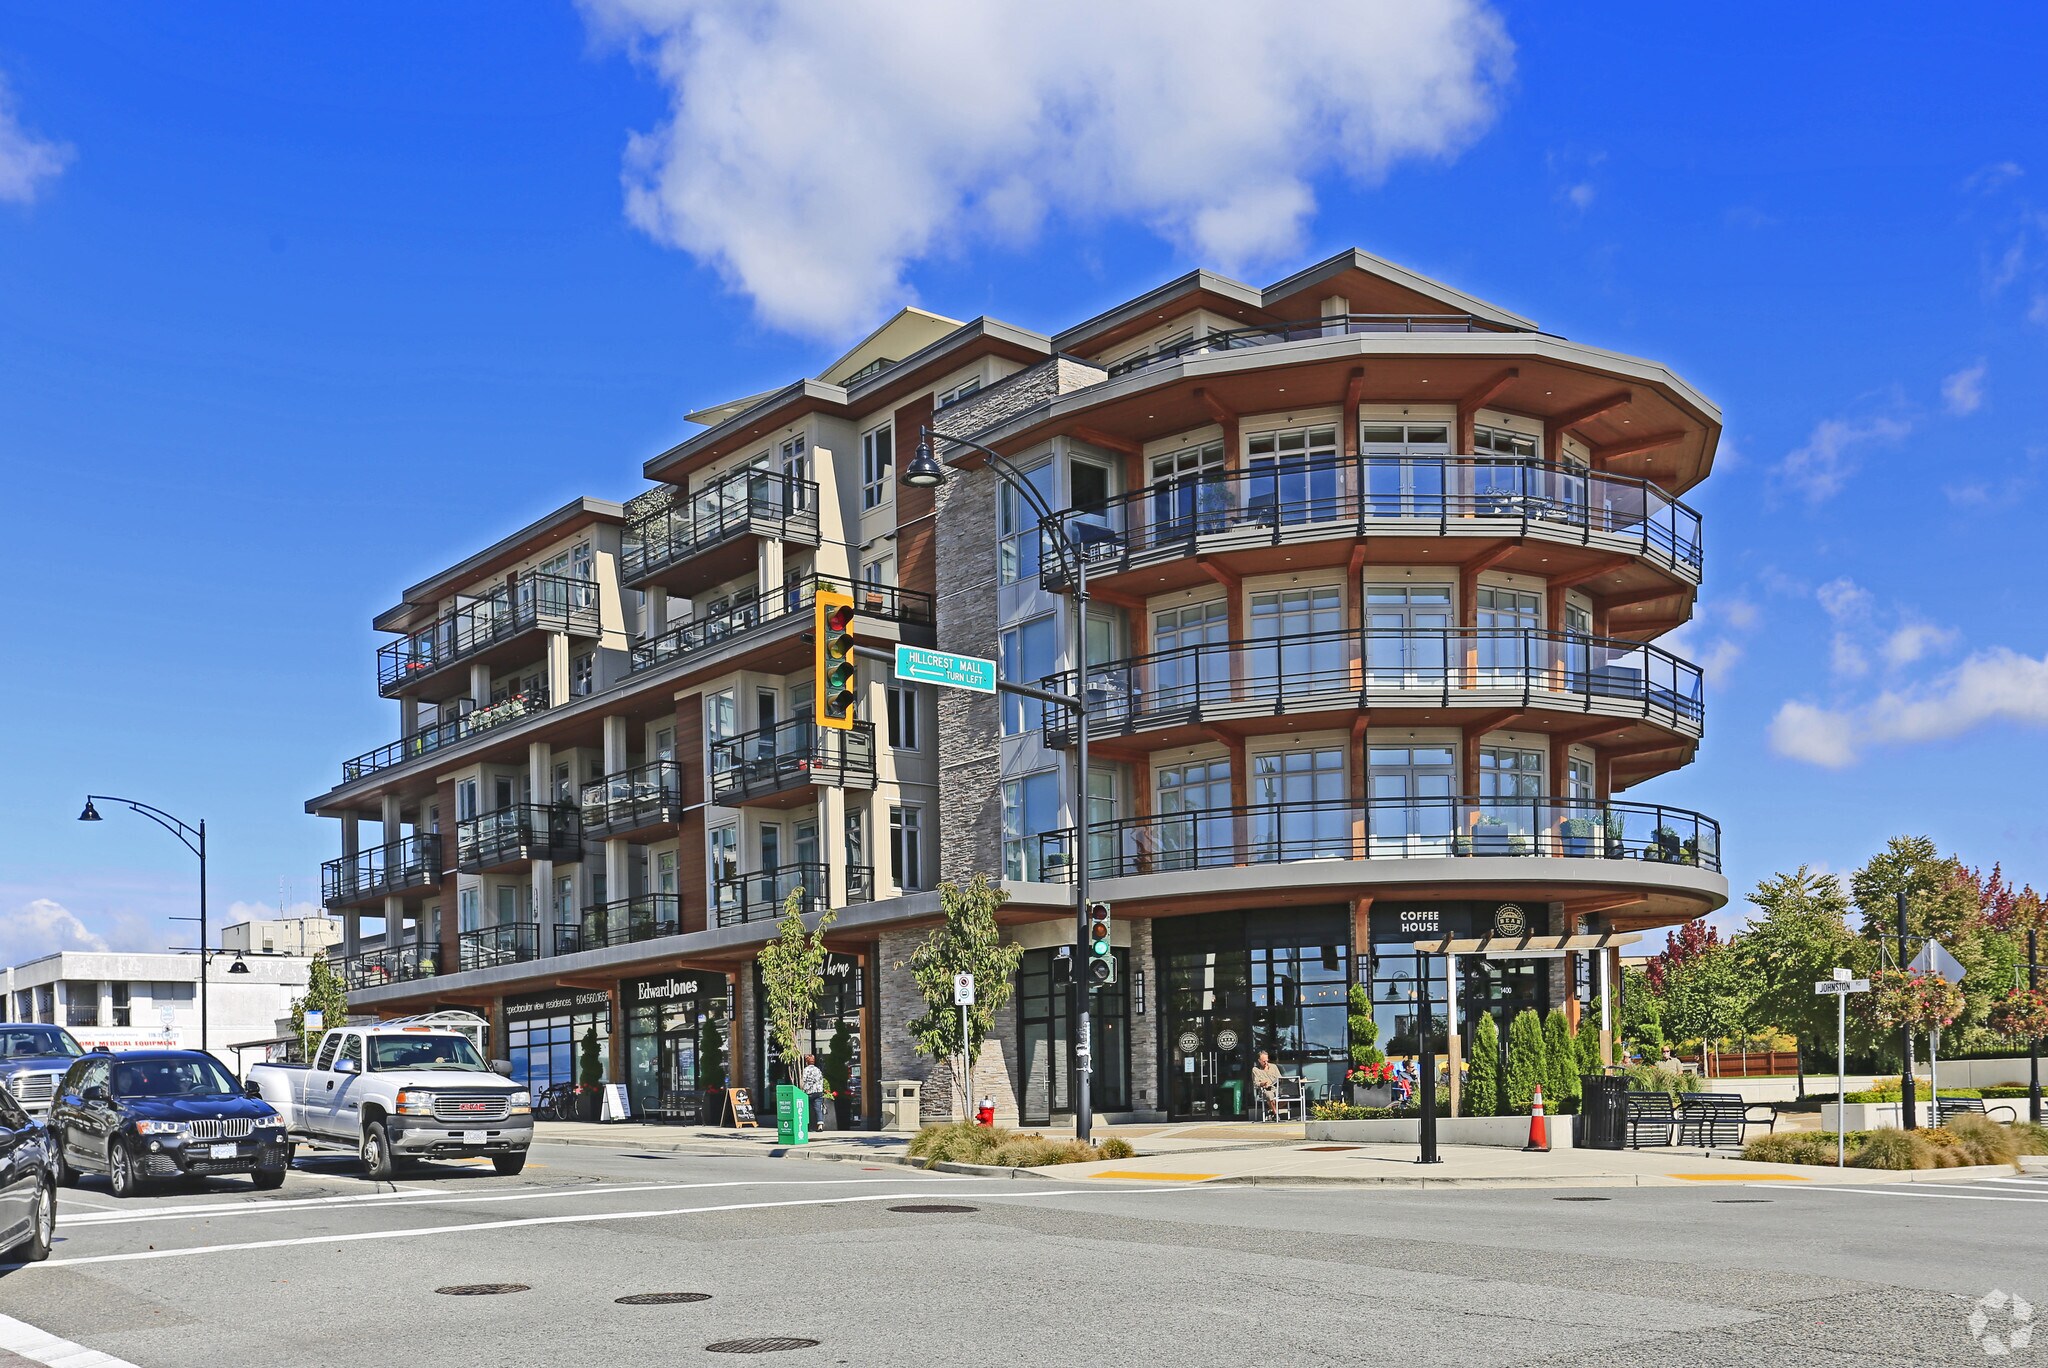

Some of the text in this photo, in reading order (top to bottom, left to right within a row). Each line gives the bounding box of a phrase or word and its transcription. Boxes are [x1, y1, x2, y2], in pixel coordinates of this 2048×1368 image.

[909, 652, 983, 674] HILLCREST MALL
[946, 671, 983, 685] TURN LEFT
[1400, 911, 1439, 921] COFFEE
[1401, 922, 1439, 932] HOUSE
[826, 953, 850, 978] home
[1820, 982, 1850, 993] JOHNSTON
[506, 1003, 533, 1015] spectacular
[533, 1001, 545, 1011] view
[546, 998, 571, 1009] residences
[459, 1103, 486, 1111] GMC
